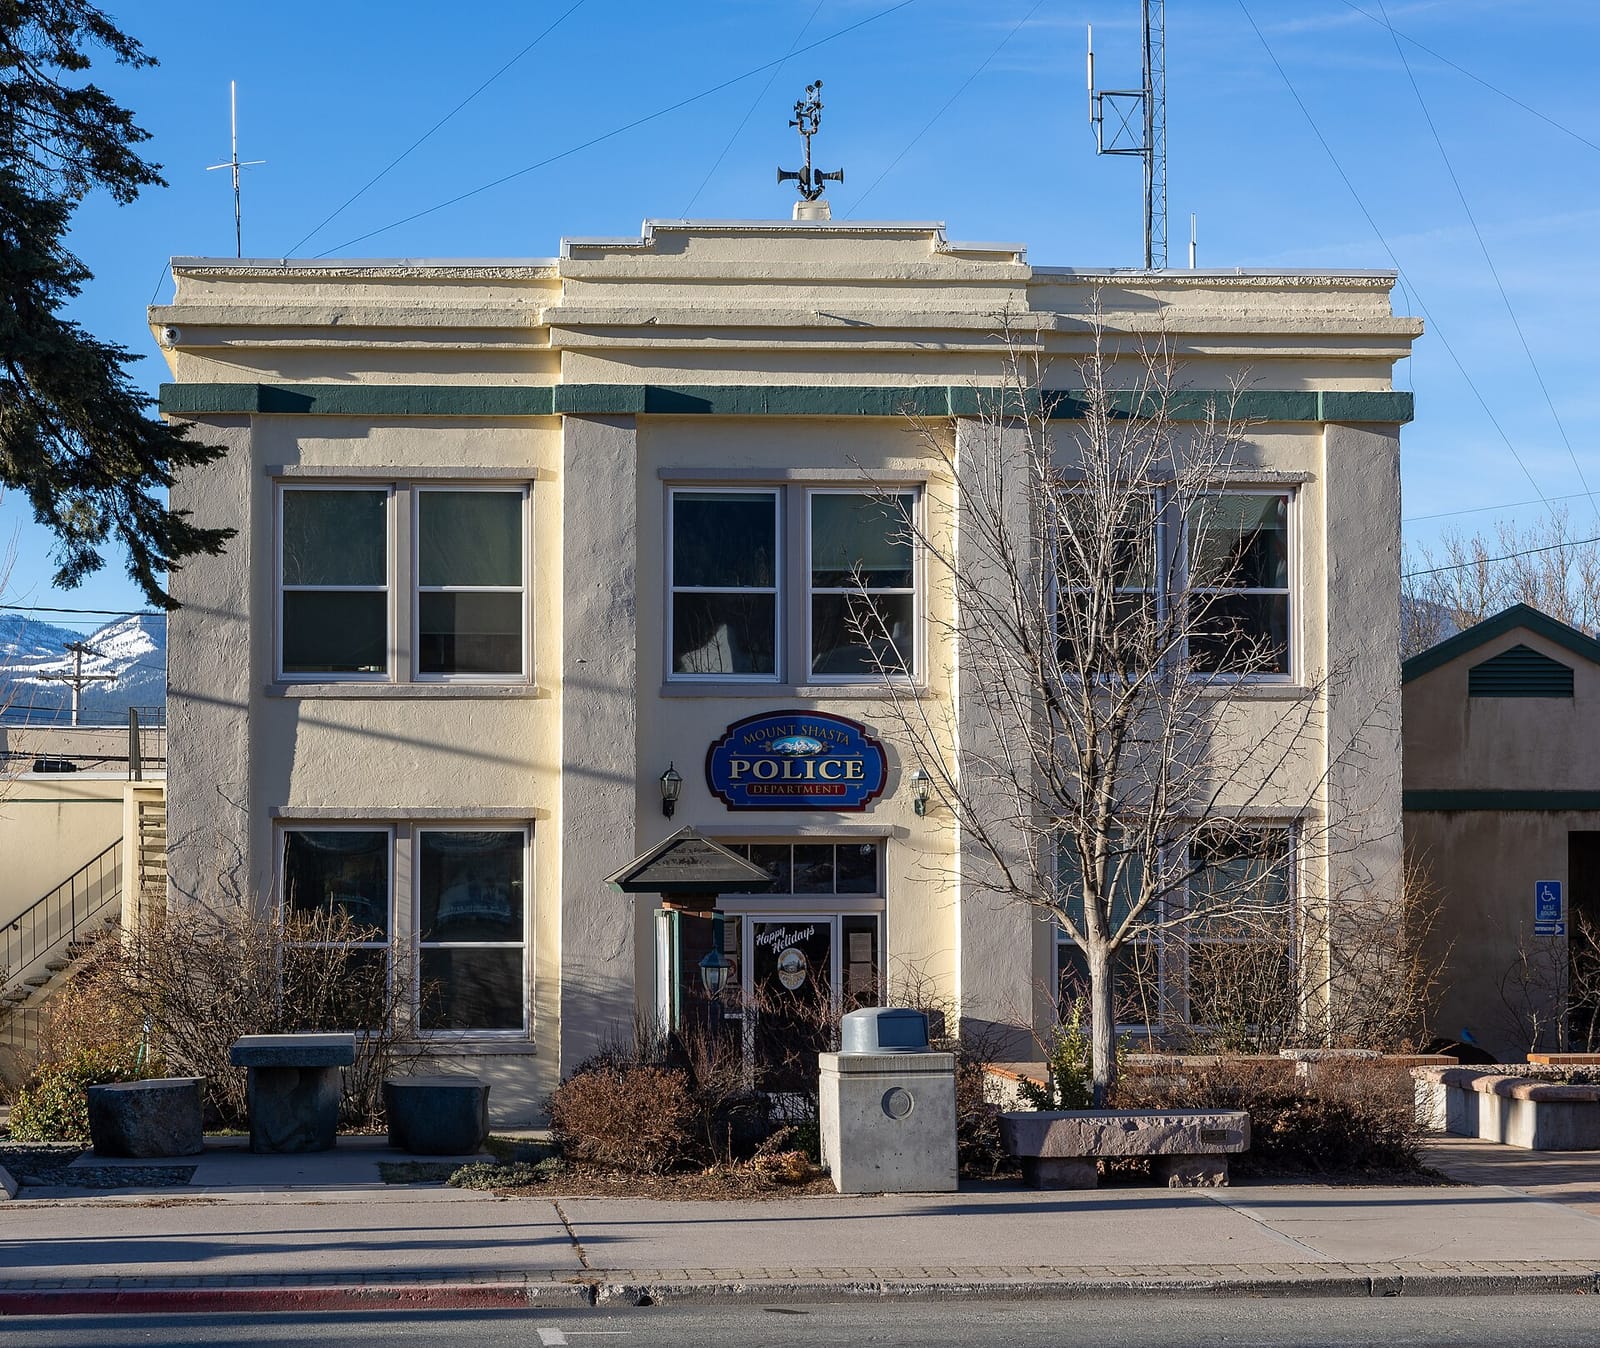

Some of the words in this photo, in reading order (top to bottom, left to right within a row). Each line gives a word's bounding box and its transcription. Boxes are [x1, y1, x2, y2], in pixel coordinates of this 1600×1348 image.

[743, 724, 796, 745] MOUNT
[801, 724, 850, 746] SHASTA
[728, 759, 865, 780] POLICE
[752, 784, 841, 795] DEPARTMENT
[755, 926, 786, 946] Happy
[771, 924, 815, 955] Holidays
